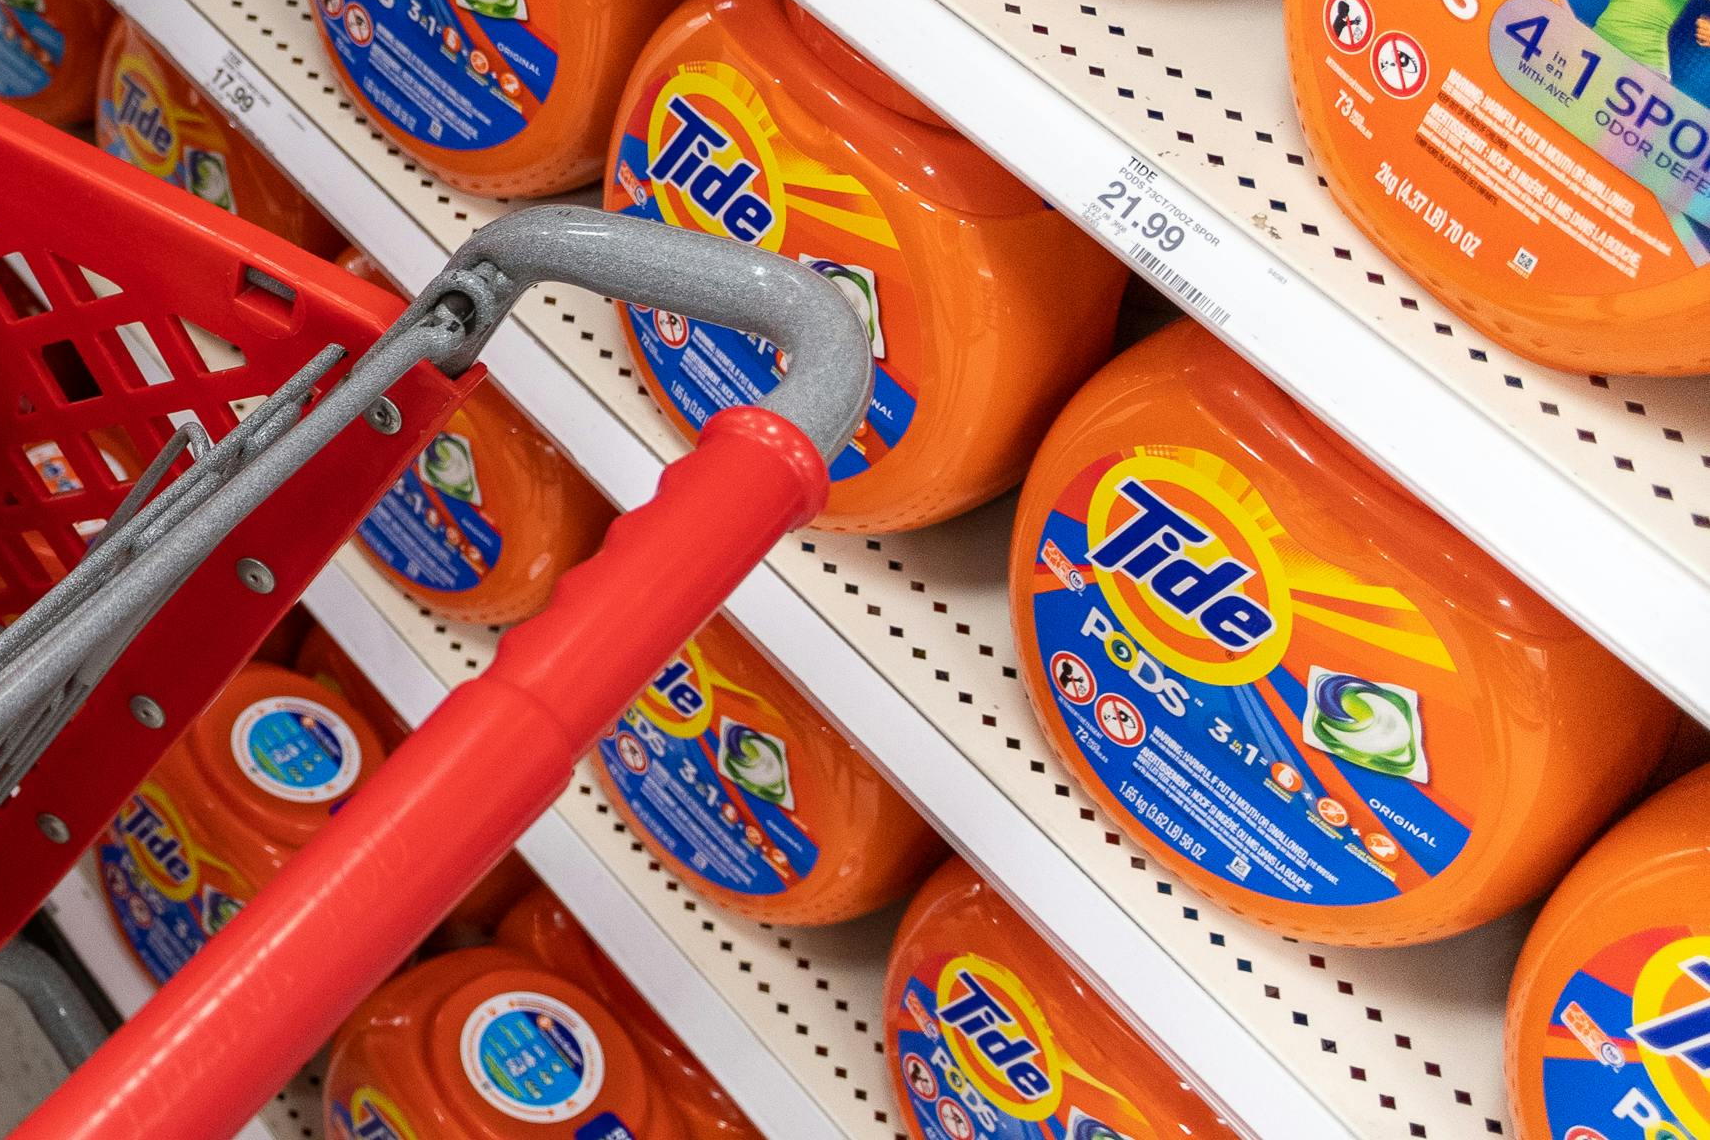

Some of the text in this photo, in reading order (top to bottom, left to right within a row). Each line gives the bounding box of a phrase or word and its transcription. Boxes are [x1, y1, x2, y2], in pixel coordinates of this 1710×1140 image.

[497, 42, 540, 76] ORIGINAL
[1505, 15, 1551, 62] 4
[120, 72, 173, 157] Tide
[1594, 110, 1653, 159] ODOR
[647, 94, 775, 244] Tide
[1119, 167, 1144, 189] PODS
[1193, 224, 1220, 247] SPOR
[1128, 156, 1158, 183] TIDE
[1097, 181, 1185, 252] 21.99
[1086, 476, 1275, 652] Tide
[1081, 607, 1188, 717] PODS
[1075, 726, 1088, 743] 72
[1118, 781, 1206, 860] 1.65 (3.62 LB) 58 OZ
[1369, 799, 1437, 848] ORIGINAL
[937, 970, 1052, 1100] Tide
[931, 1046, 996, 1134] PODS
